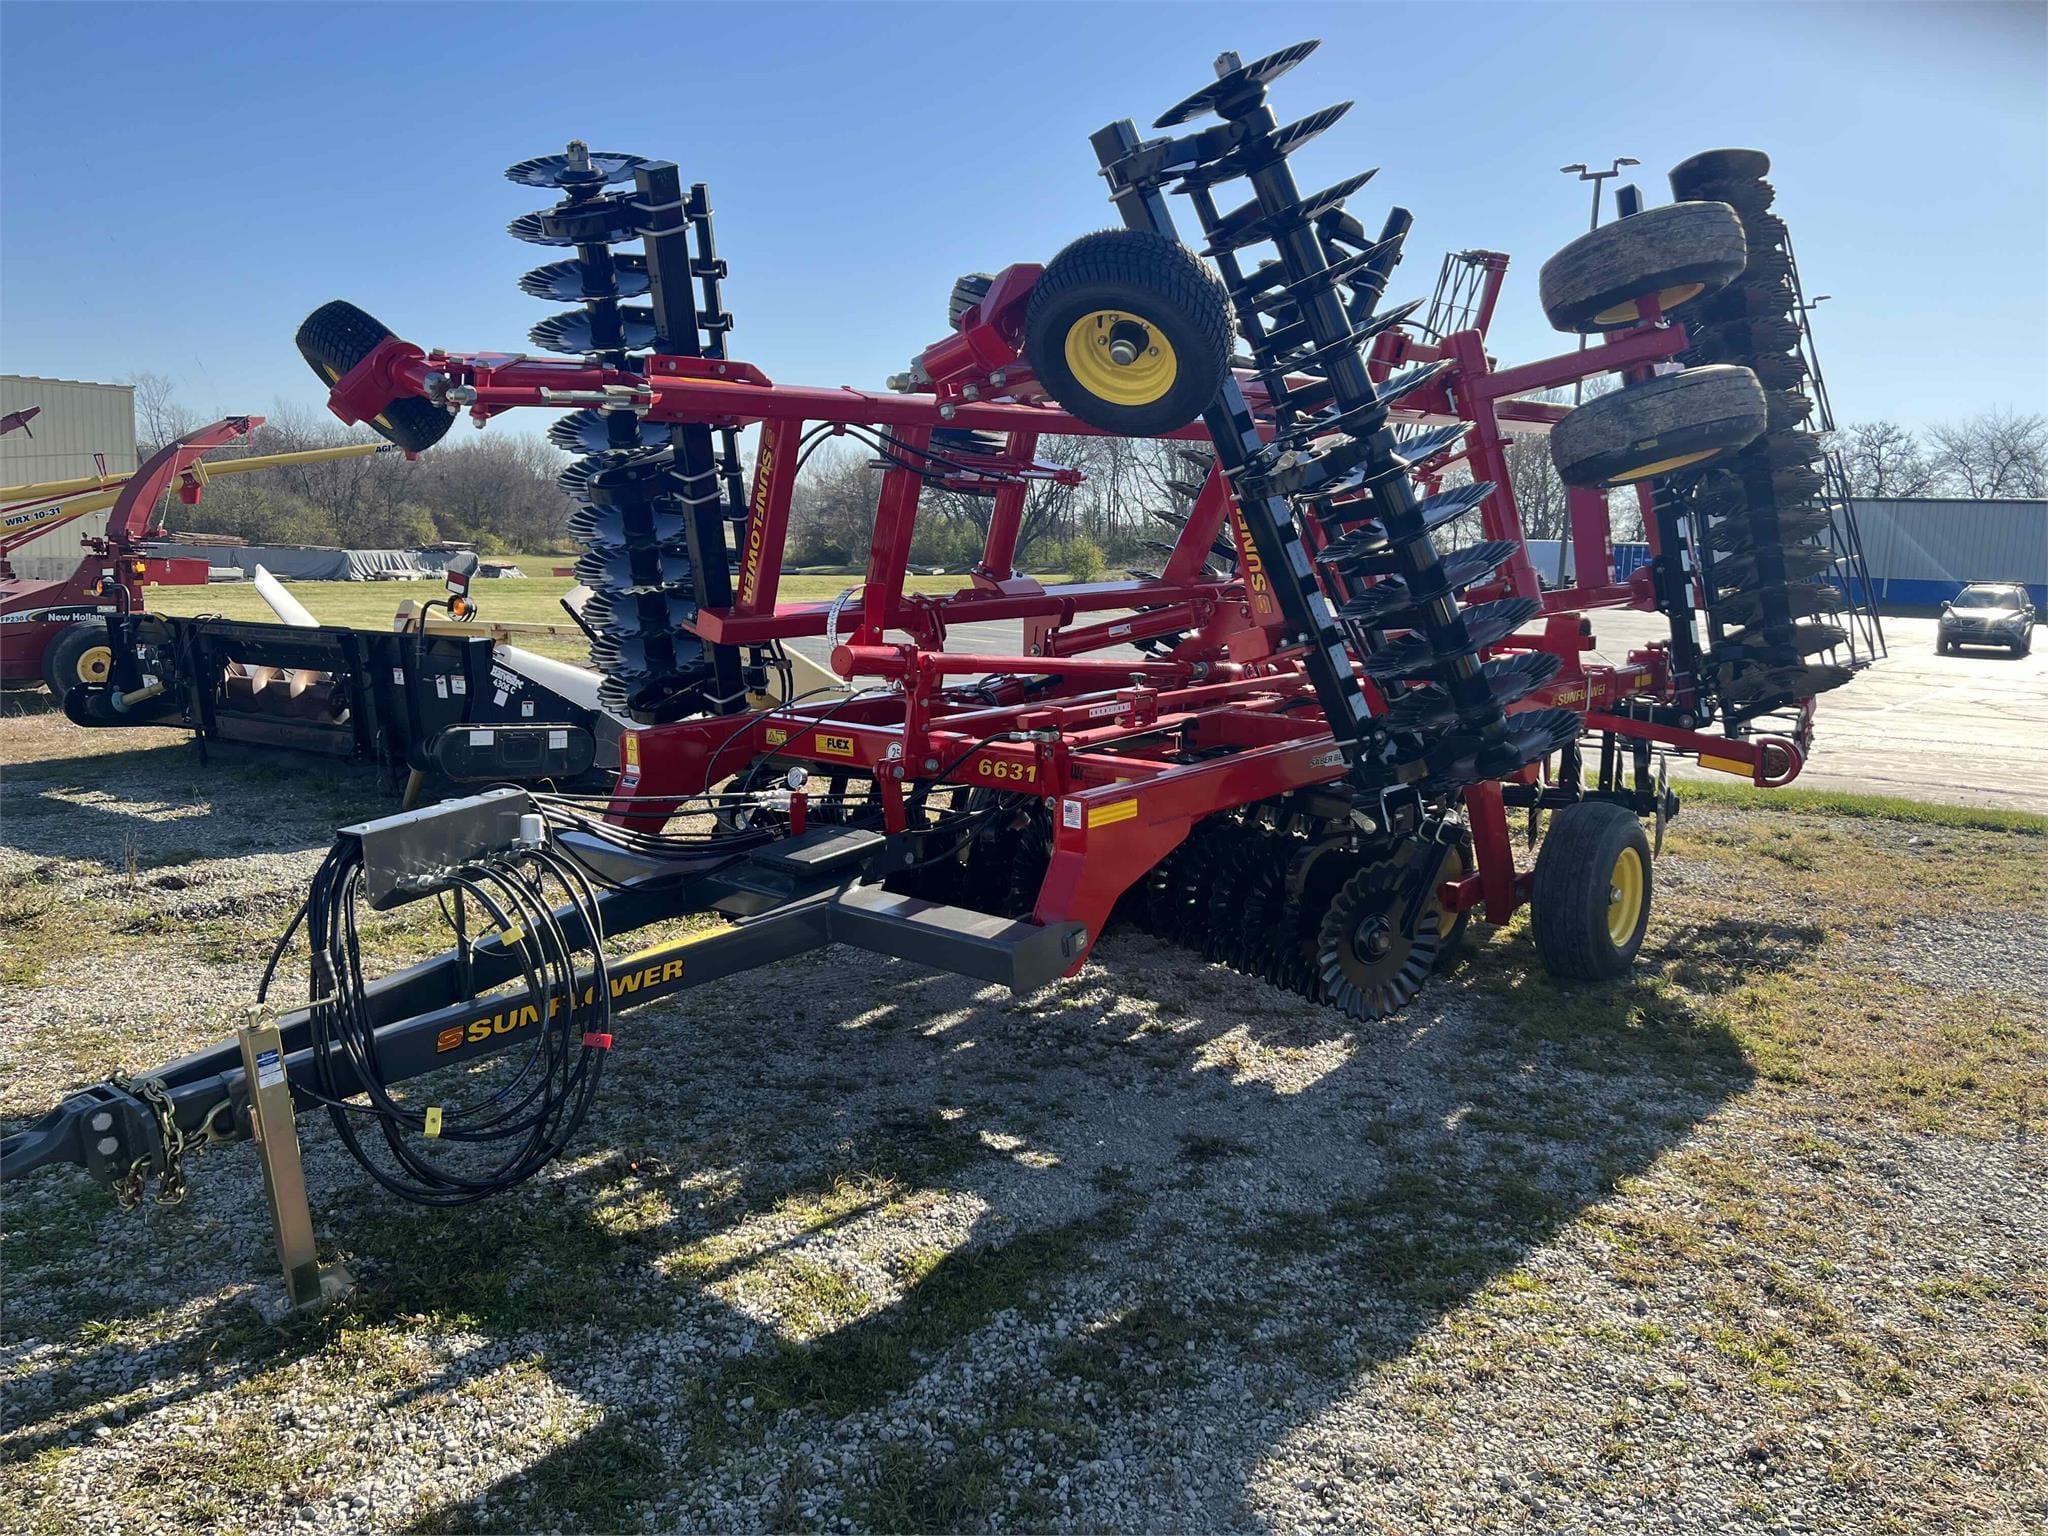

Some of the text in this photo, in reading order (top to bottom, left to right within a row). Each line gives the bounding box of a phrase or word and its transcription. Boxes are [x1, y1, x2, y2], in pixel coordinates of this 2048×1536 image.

[5, 507, 61, 526] WRX 10-31
[743, 448, 772, 606] SUNFLOWER
[48, 613, 70, 621] New
[510, 686, 516, 694] C
[827, 737, 850, 750] FLEX
[978, 758, 1037, 783] 6631
